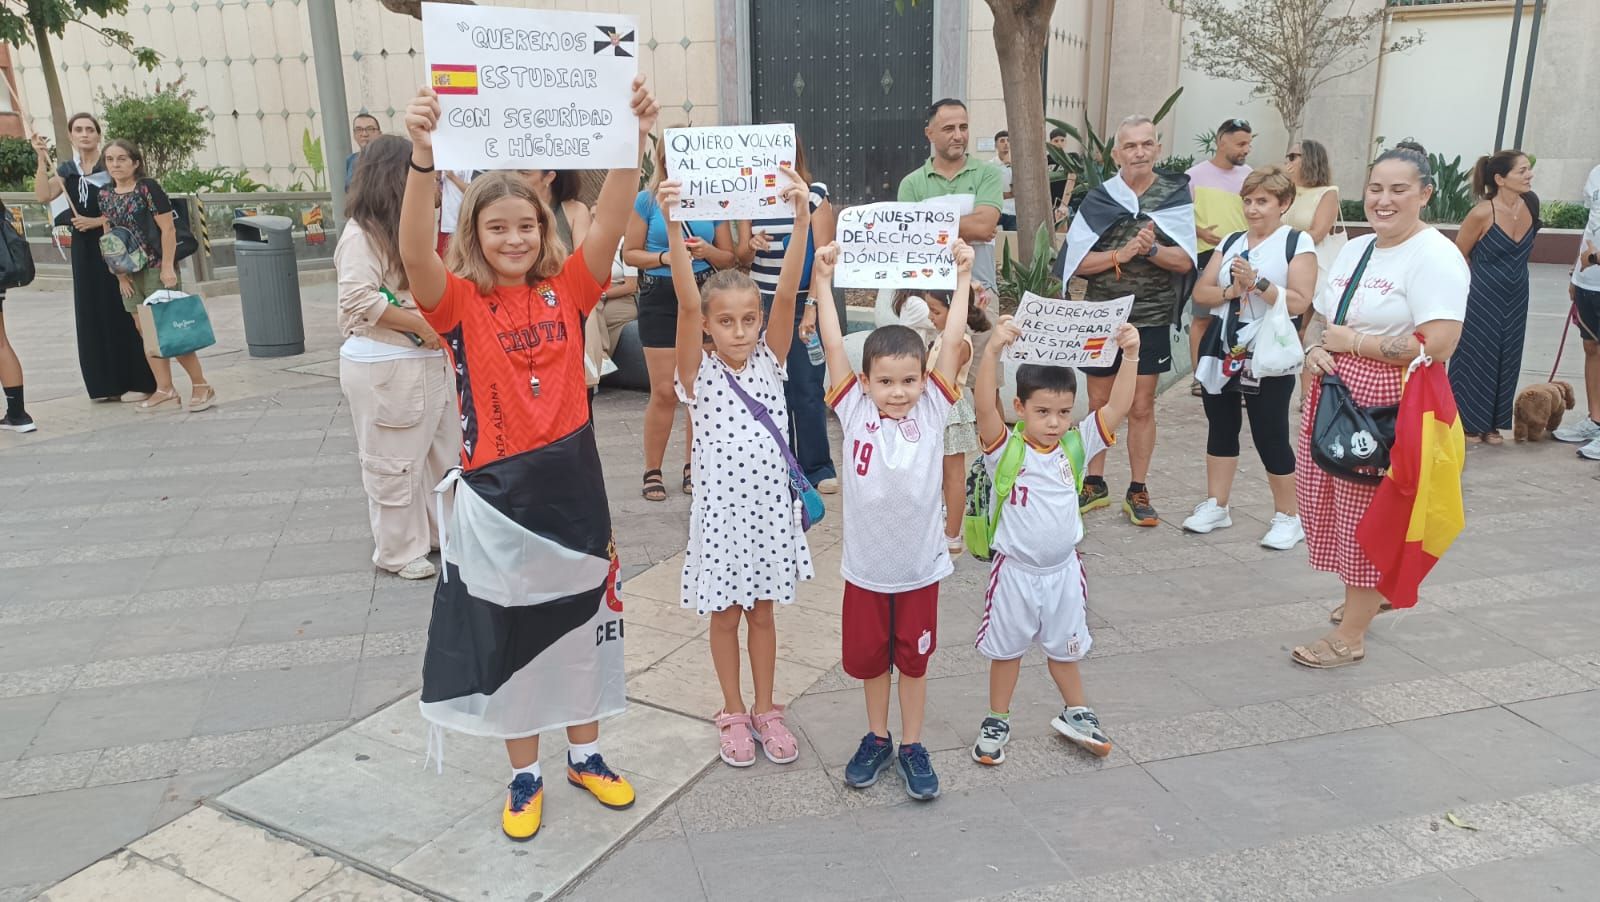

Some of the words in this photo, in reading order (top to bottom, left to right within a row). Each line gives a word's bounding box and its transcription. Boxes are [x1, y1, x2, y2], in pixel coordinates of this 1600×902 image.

[480, 65, 598, 89] ESTUDIAR
[448, 107, 490, 128] CON
[485, 138, 499, 157] E
[738, 132, 793, 148] VOLVER
[678, 158, 700, 170] AL
[705, 155, 745, 169] COLE
[872, 210, 955, 224] NUESTROS
[842, 229, 936, 246] DERECHOS
[843, 247, 899, 264] DÓNDE
[1025, 301, 1110, 319] QUEREMOS
[1021, 319, 1112, 334] RECUPERAR
[495, 434, 506, 457] NTA
[1010, 483, 1029, 507] 17
